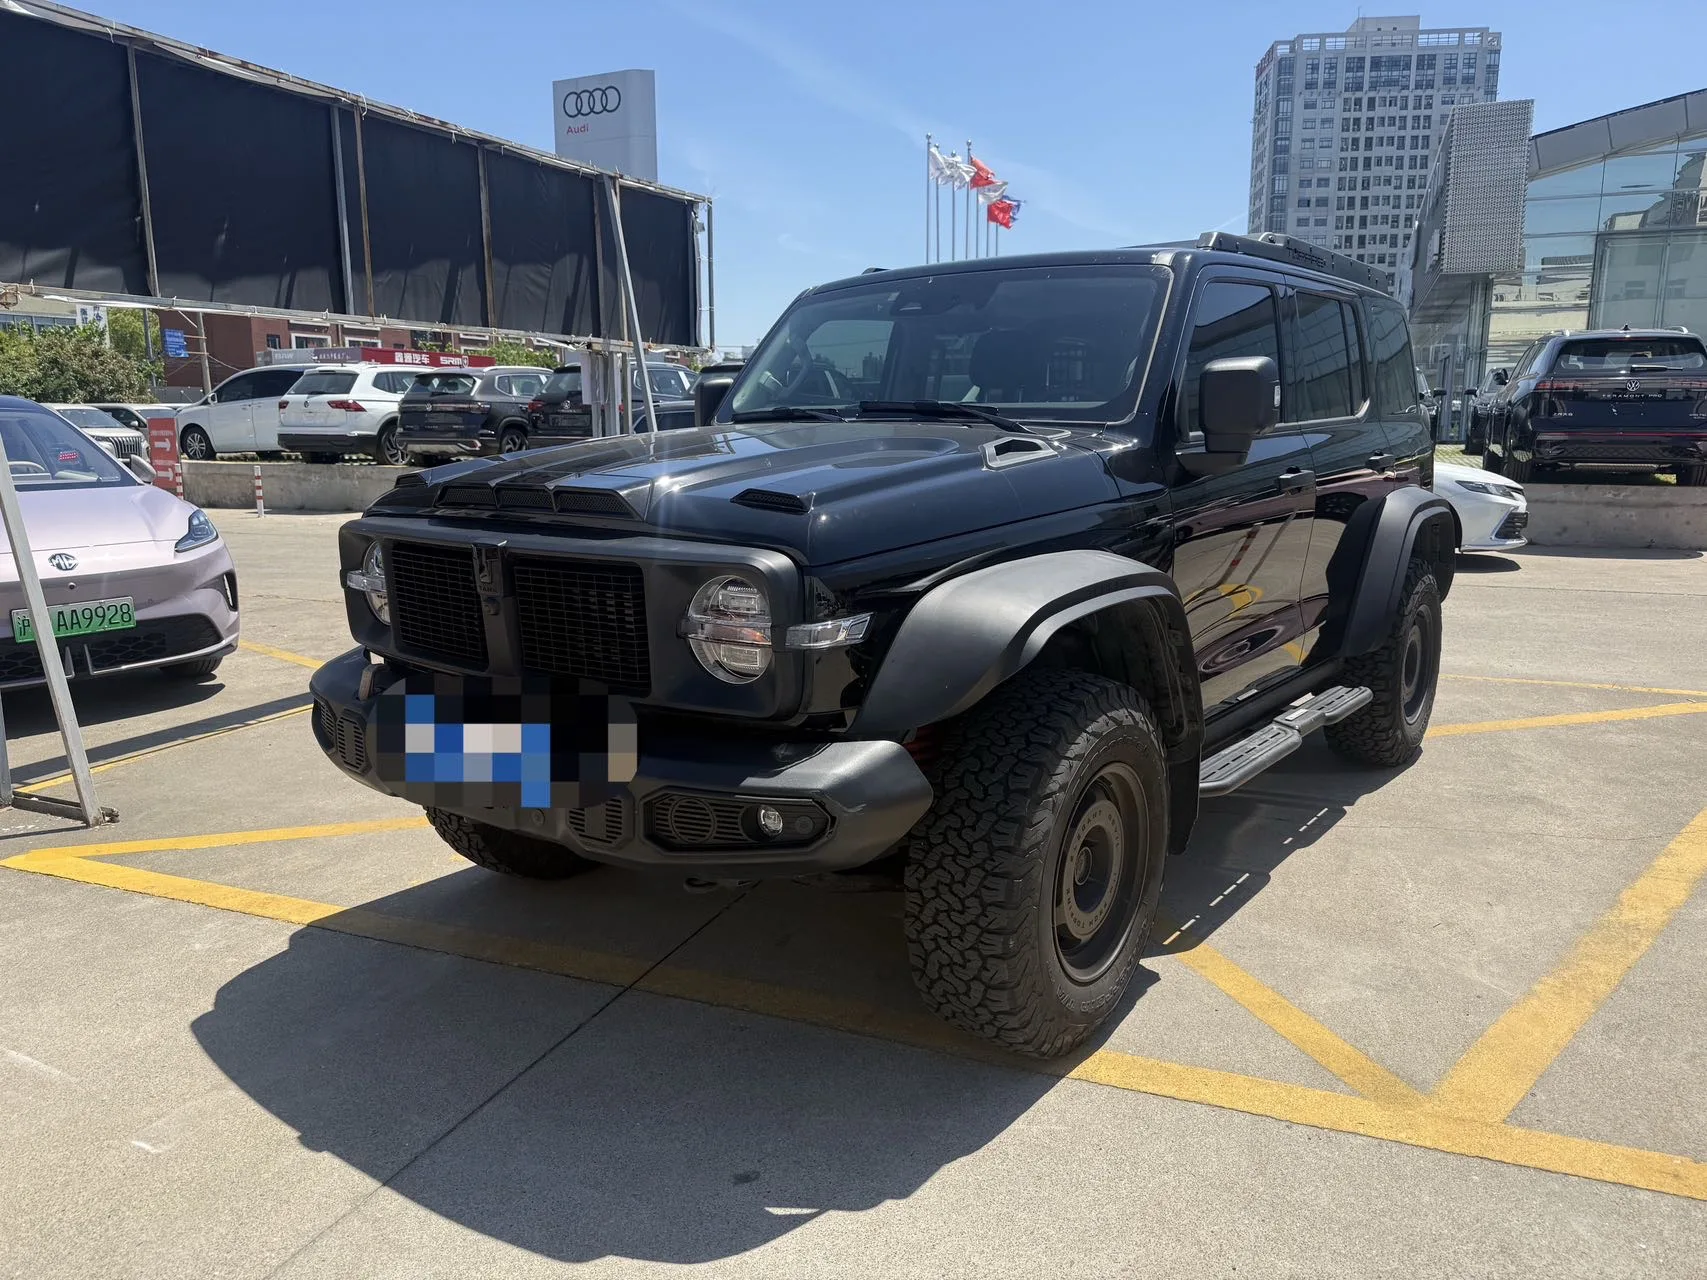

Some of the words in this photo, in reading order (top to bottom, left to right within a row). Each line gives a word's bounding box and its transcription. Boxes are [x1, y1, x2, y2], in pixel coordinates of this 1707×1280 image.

[566, 123, 589, 135] Audi
[50, 553, 78, 570] MG
[17, 603, 132, 637] 沪AA9928
